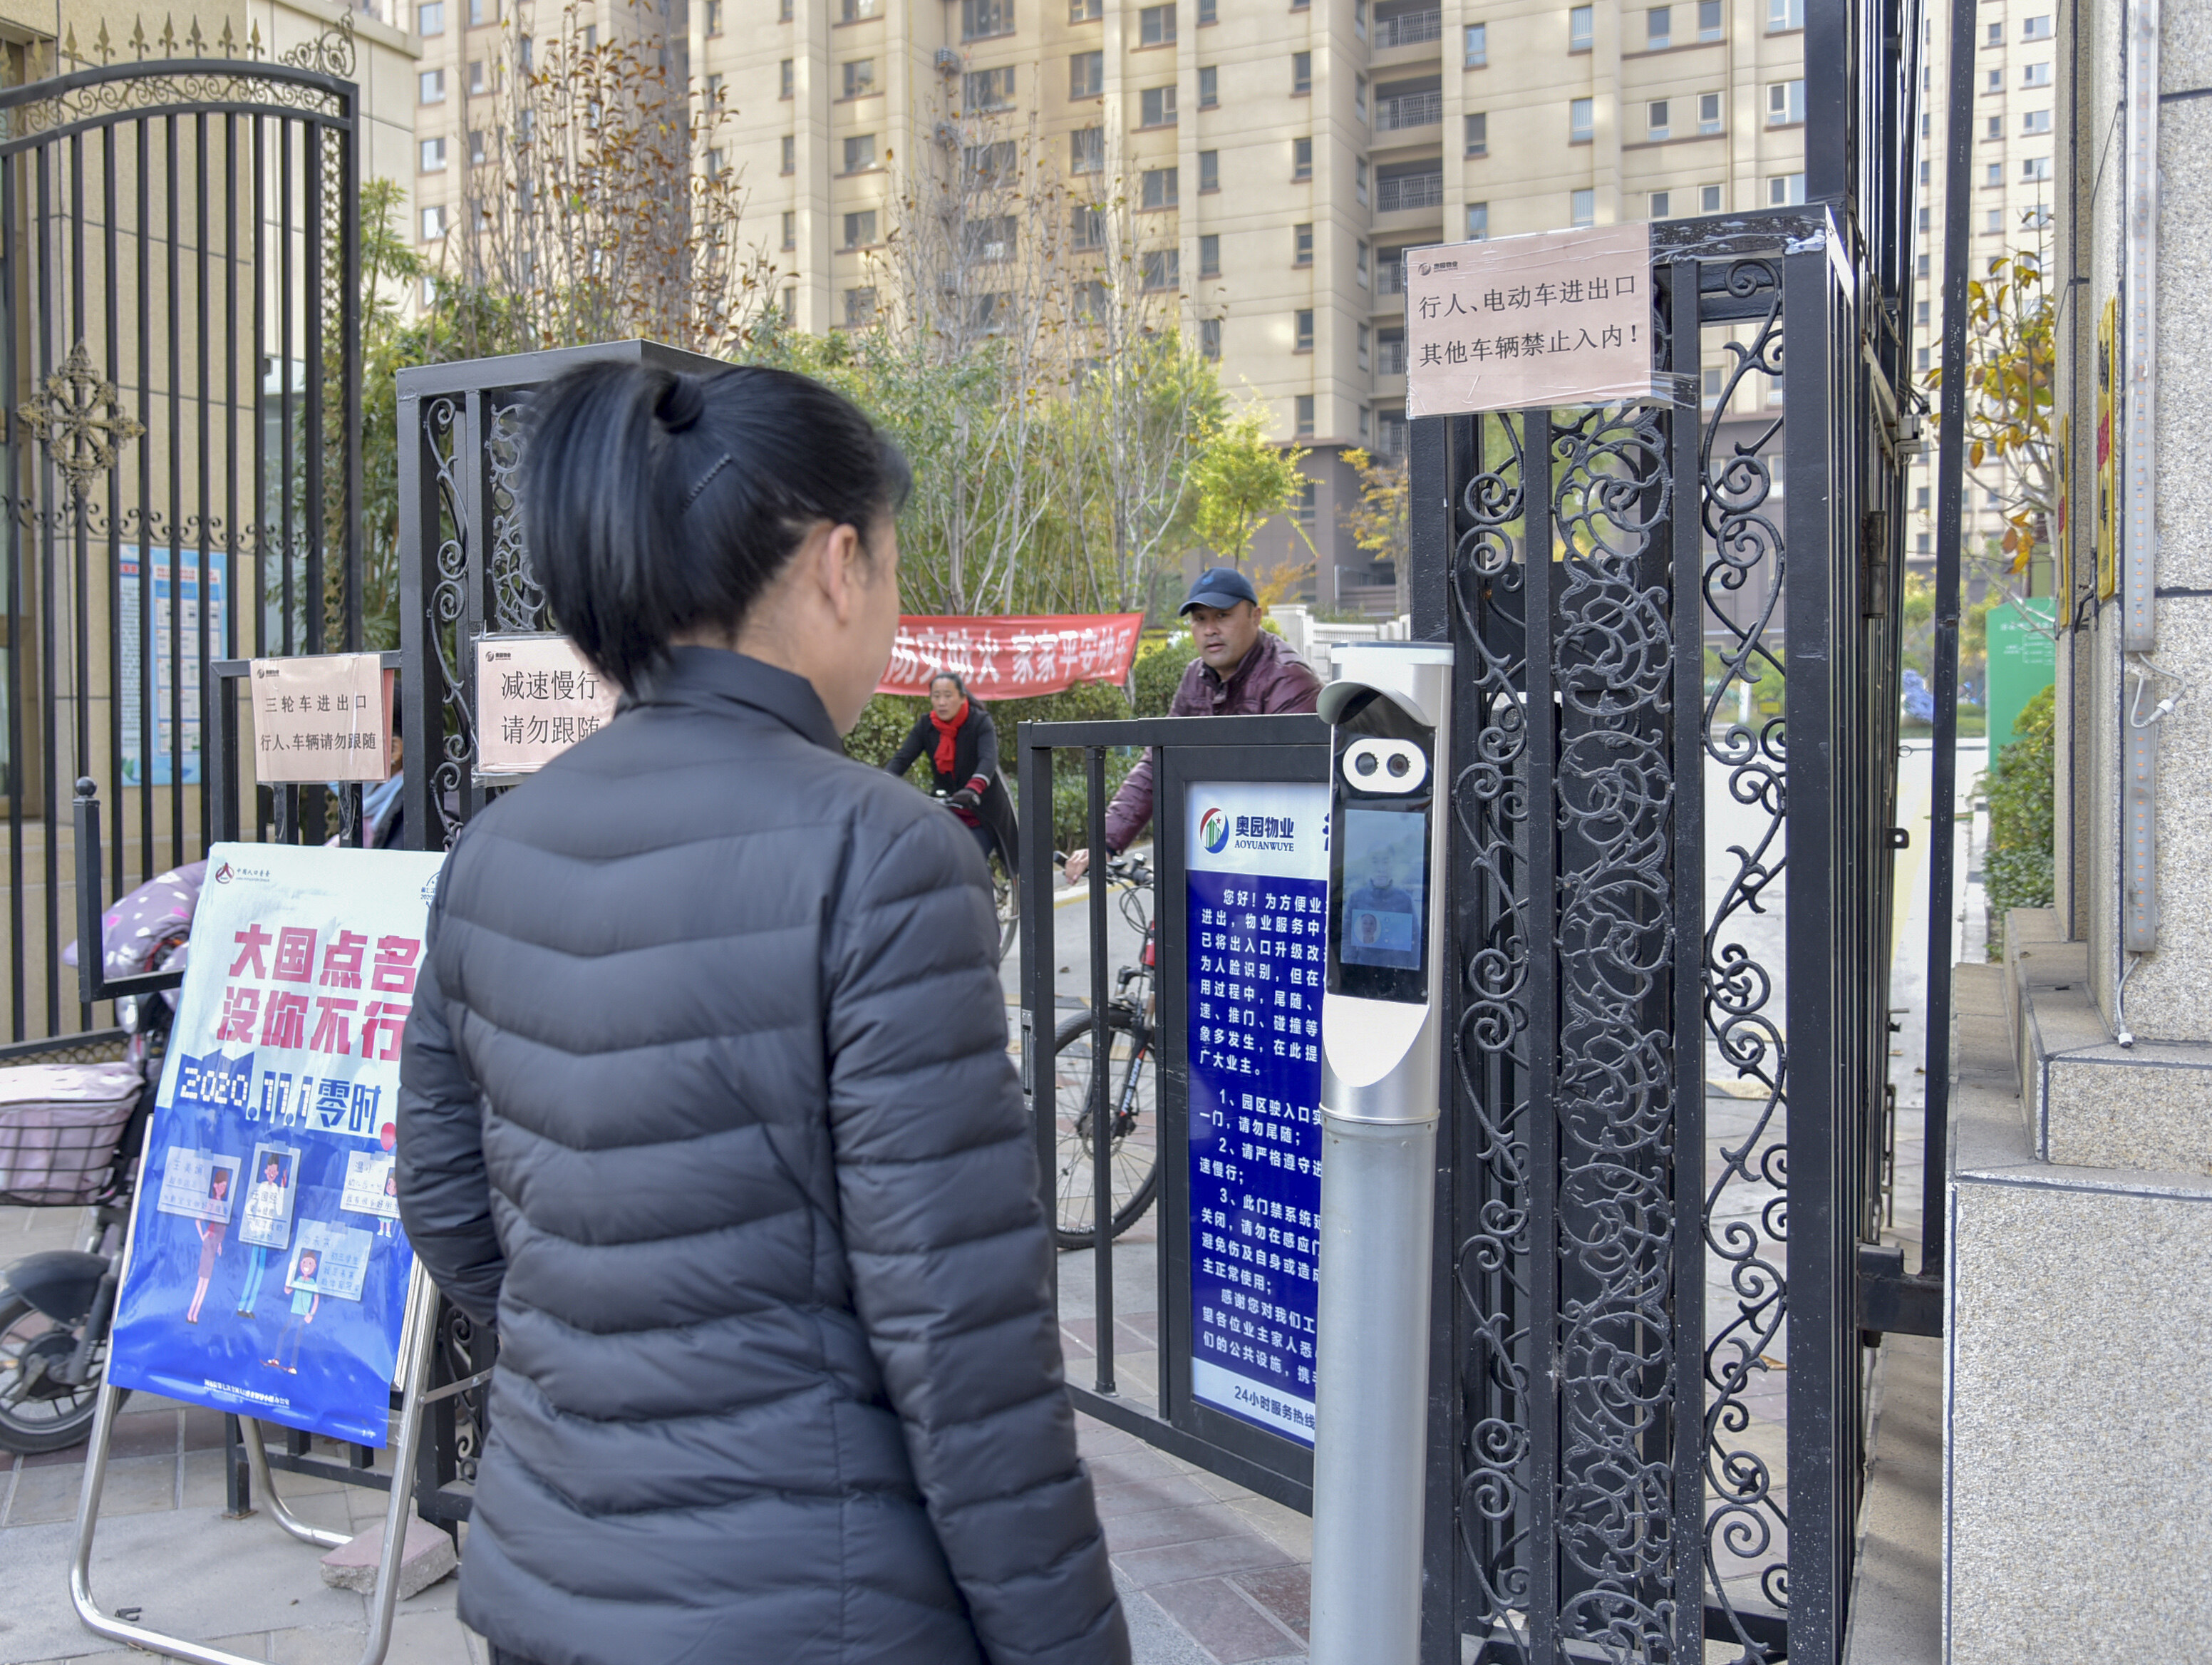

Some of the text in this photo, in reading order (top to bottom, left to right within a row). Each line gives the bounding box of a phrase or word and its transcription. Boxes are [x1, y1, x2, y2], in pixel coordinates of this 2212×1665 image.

[1419, 275, 1635, 319] 行人、电动车进出口
[1420, 324, 1637, 368] 其他车辆禁止入内！
[501, 669, 600, 701] 减速慢行
[265, 694, 367, 713] 三轮车进出口
[261, 732, 377, 751] 行人、车辆请勿跟随
[501, 714, 600, 744] 请勿跟随
[1235, 815, 1294, 838] 奥园物业
[1234, 840, 1294, 852] AOYUANWUYE
[1224, 889, 1327, 914] 您好！为方便业
[1201, 909, 1327, 937] 进出，物业服务中
[229, 923, 420, 994] 大国点名
[1201, 932, 1325, 962] 已将出入口升级改
[1201, 955, 1325, 987] 为人脸识别，但在
[1201, 979, 1312, 1011] 用过程中，尾随、
[216, 986, 411, 1061] 没你不行
[1200, 1002, 1318, 1037] 速、推门、碰撞等
[1200, 1026, 1318, 1063] 象多发生，在此提
[1199, 1049, 1260, 1075] 广大业主。
[180, 1067, 381, 1135] 2020.11.1零时
[1199, 1110, 1300, 1146] 一门，请勿尾随；
[1199, 1157, 1244, 1185] 速慢行；
[1219, 1137, 1323, 1177] 2、请严格遵守进
[1202, 1257, 1271, 1295] 主正常使用；
[1221, 1289, 1316, 1334] 感谢您对我们工
[1202, 1306, 1317, 1359] 望各位业主家人悉
[1234, 1386, 1316, 1431] 24小时服务热线
